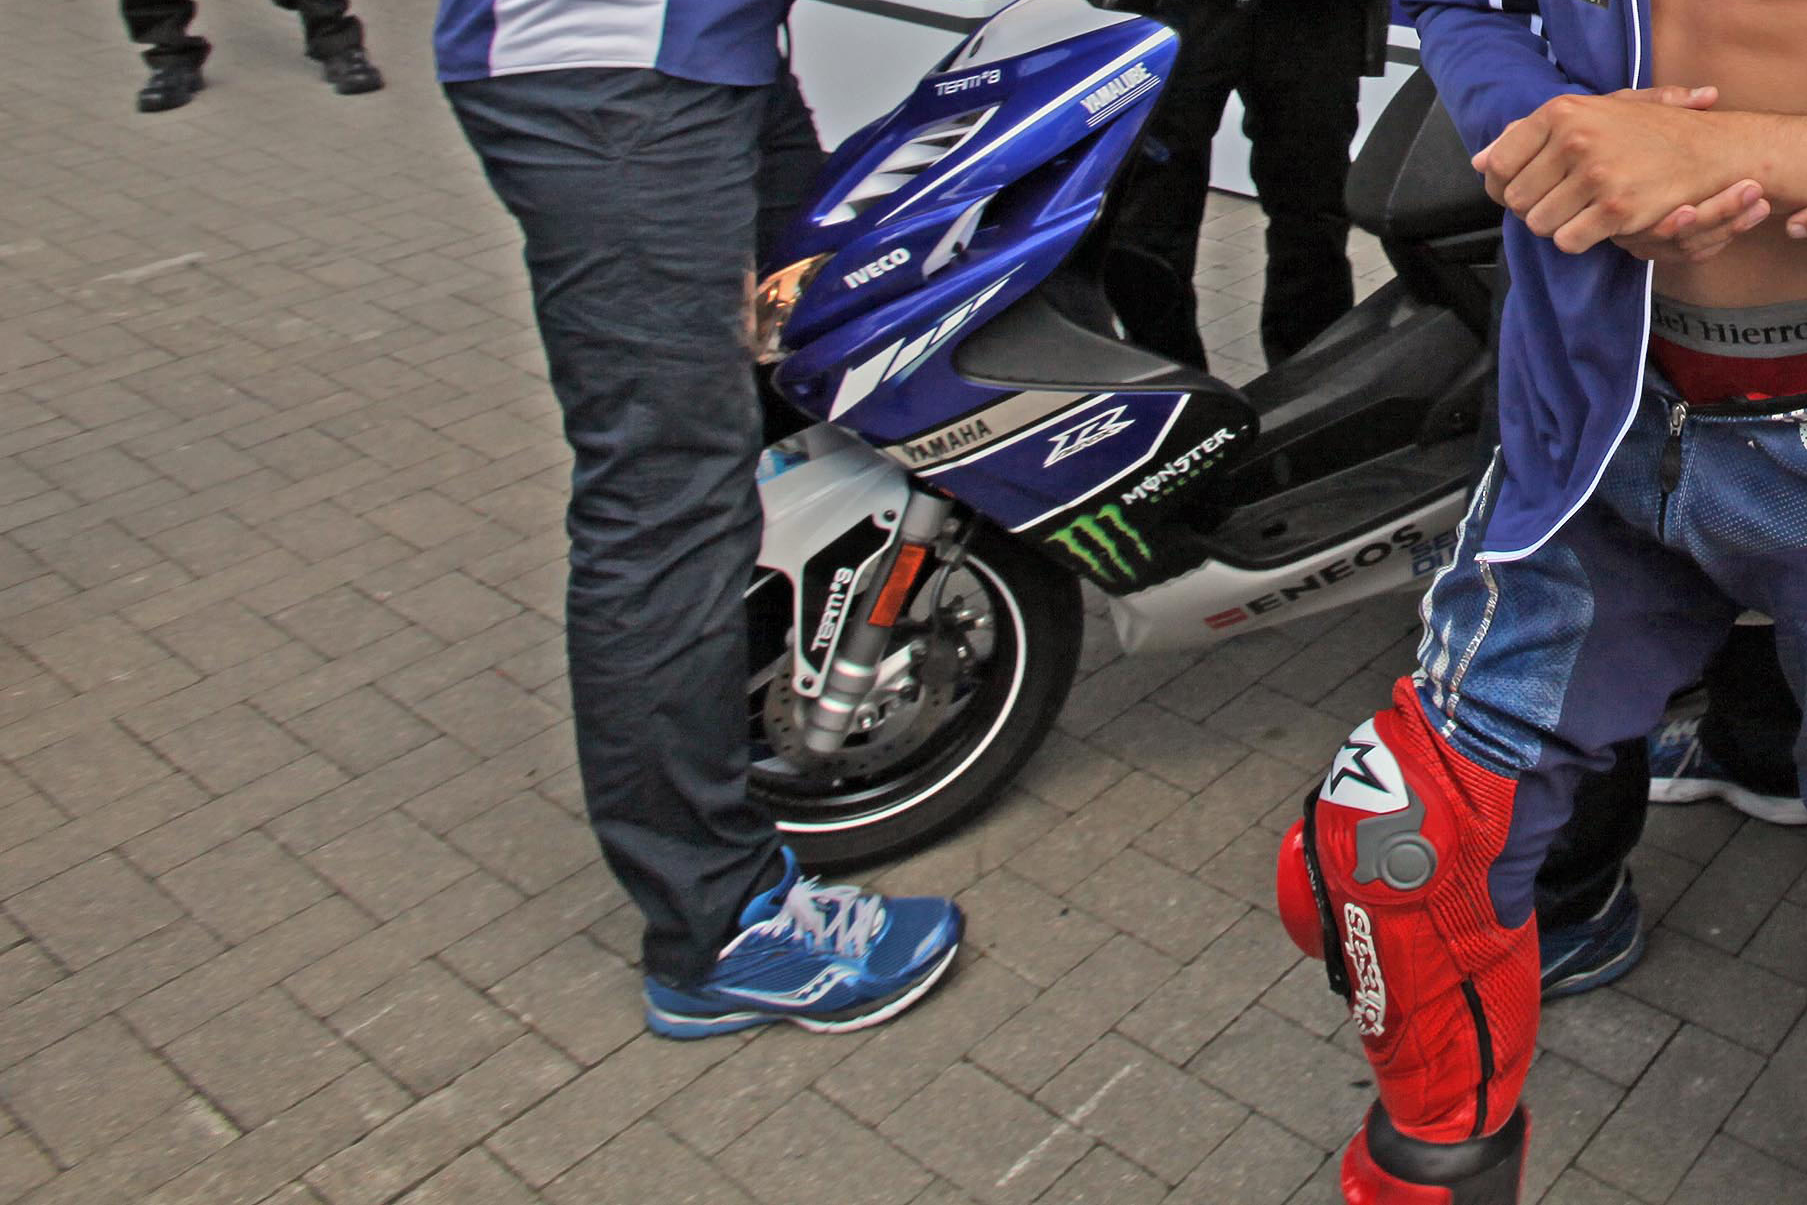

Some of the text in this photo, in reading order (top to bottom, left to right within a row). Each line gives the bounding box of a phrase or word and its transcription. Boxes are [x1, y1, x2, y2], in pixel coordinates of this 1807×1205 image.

[1080, 61, 1153, 115] YAMALUBE
[843, 247, 912, 289] IVECO
[902, 418, 993, 464] YAMAHA
[1120, 426, 1236, 506] MONSTER
[1245, 522, 1424, 616] ENEOS
